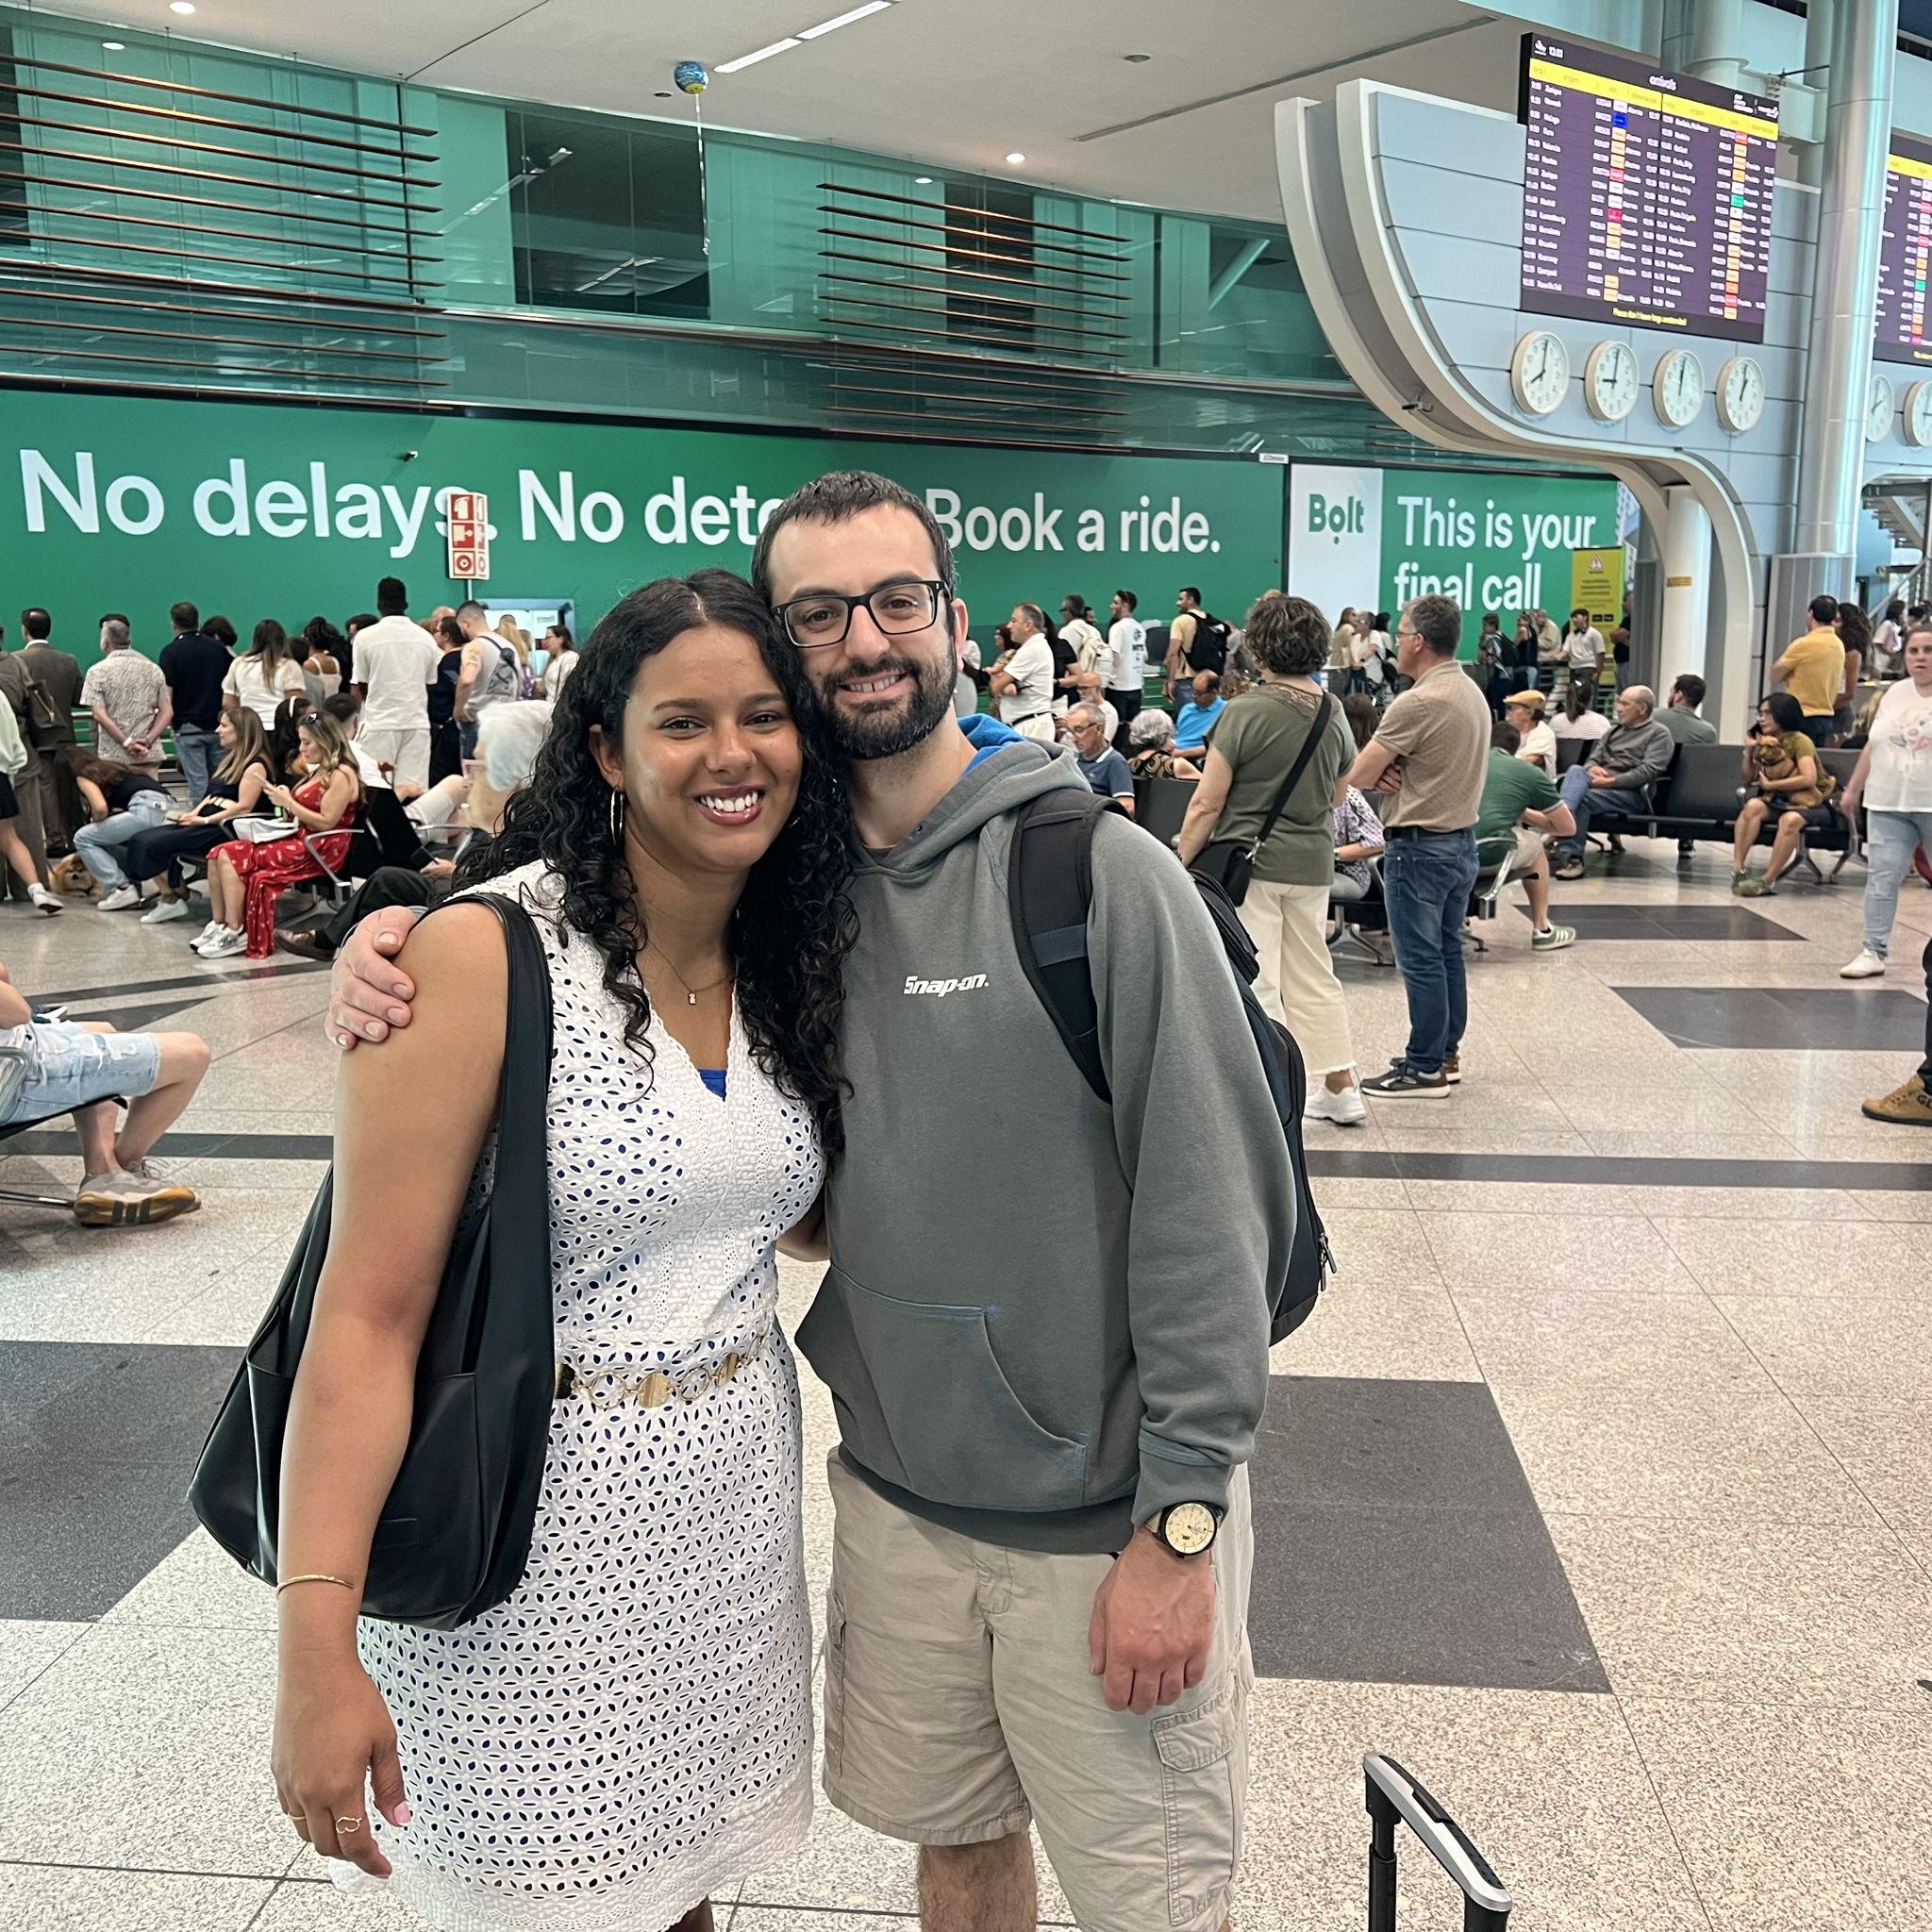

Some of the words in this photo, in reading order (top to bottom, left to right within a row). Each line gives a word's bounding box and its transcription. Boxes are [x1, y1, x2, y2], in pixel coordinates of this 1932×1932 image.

[21, 450, 164, 535] No
[519, 470, 624, 543] No
[926, 488, 1064, 552] Book
[1077, 509, 1105, 552] a
[1122, 495, 1221, 554] ride.
[1308, 493, 1365, 544] Bolt
[1397, 495, 1475, 549] This
[1486, 498, 1513, 549] is
[1523, 514, 1596, 561] your
[1393, 561, 1474, 612] final
[1482, 562, 1541, 611] call
[903, 973, 990, 998] Snap-on.
